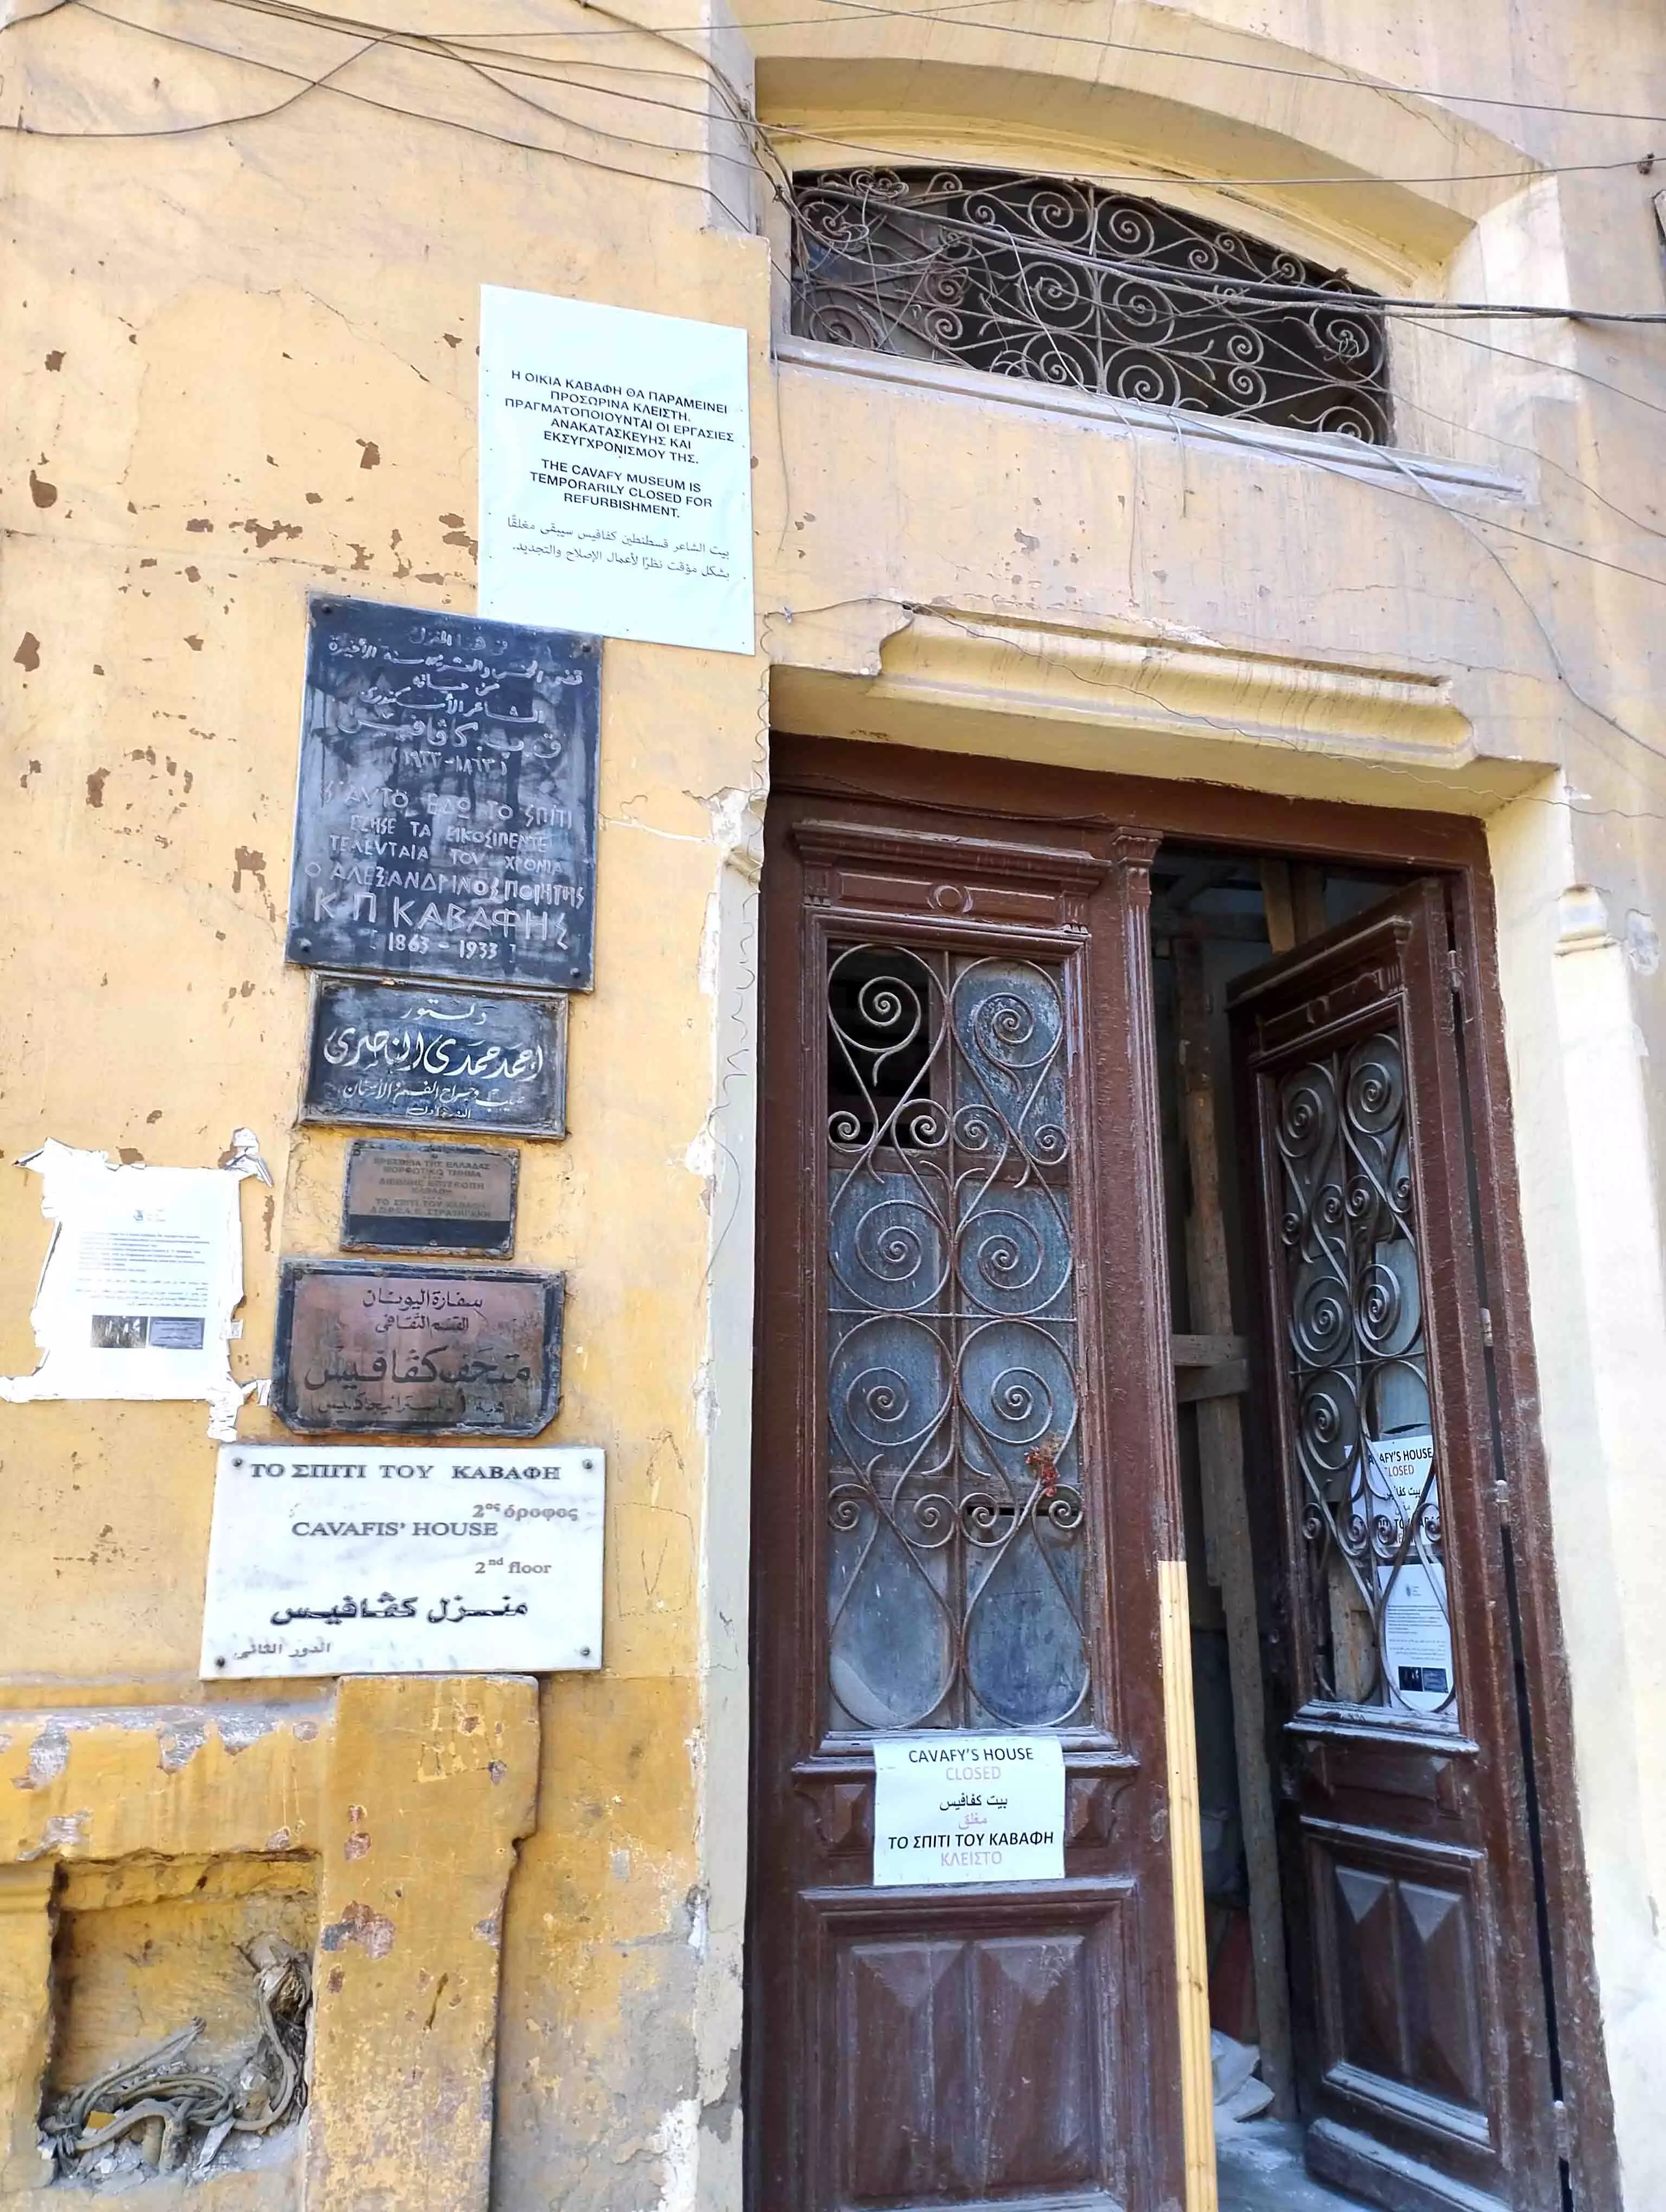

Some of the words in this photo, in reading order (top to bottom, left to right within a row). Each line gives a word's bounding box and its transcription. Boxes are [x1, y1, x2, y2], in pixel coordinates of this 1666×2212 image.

[511, 370, 520, 380] Η
[525, 373, 561, 387] ΟΙΚΙΑ
[566, 379, 621, 395] ΚΑΒΑΦΗ
[626, 388, 644, 399] ΘΑ
[649, 391, 727, 414] ΠΑΡΑΜΕΙΝΕΙ
[550, 390, 629, 410] ΠΡΟΣΩΡΙΝΑ
[633, 403, 691, 421] ΚΛΕΙΣΤΗ.
[505, 398, 652, 430] ΠΡΑΓΜΑΤΟΠΟΙΟΥΝΤΑΙ
[656, 422, 669, 433] ΟΙ
[674, 425, 734, 442] ΕΡΓΑΣΙΕΣ
[551, 418, 667, 446] ΑΝΑΚΑΤΑΣΚΕΥΗΣ
[670, 438, 691, 449] ΚΑΙ
[544, 430, 665, 459] ΕΚΣΥΓΧΡΟΝΙΣΜΟΥ
[669, 451, 699, 464] ΤΗΣ.
[541, 459, 568, 472] THE
[572, 465, 622, 481] CAVAFY
[627, 473, 685, 490] MUSEUM
[689, 482, 701, 492] IS
[530, 472, 624, 495] TEMPORARILY
[629, 487, 682, 503] CLOSED
[686, 496, 712, 507] FOR
[564, 493, 680, 518] REFURBISHMENT.
[672, 542, 705, 552] الشاعر
[709, 546, 729, 560] بيت
[701, 565, 729, 581] بشكل
[410, 821, 432, 838] ΤΑ
[392, 896, 569, 950] ΚΑΒΑΦΗΣ
[362, 1288, 430, 1311] اليونان
[432, 1290, 483, 1310] سفارة
[1403, 1448, 1433, 1462] HOUSE
[251, 1463, 286, 1478] ΤΟ
[291, 1463, 368, 1478] ΣΠΙΤΙ
[379, 1464, 435, 1479] ΤΟΥ
[451, 1465, 562, 1480] ΚΑΒΑΦΗ
[1385, 1464, 1414, 1477] LOSED
[412, 1522, 499, 1536] HOUSE
[507, 1560, 552, 1574] floor
[426, 1594, 529, 1624] منزل
[983, 1747, 1034, 1761] HOUSE
[946, 1766, 1002, 1780] CLOSED
[939, 1792, 982, 1811] كفافيس
[986, 1795, 1008, 1809] بيت
[887, 1836, 909, 1850] ΤΟ
[913, 1834, 951, 1849] ΣΠΙΤΙ
[955, 1833, 985, 1847] ΤΟΥ
[989, 1831, 1054, 1846] ΚΑΒΑΦΗ
[941, 1850, 1003, 1867] ΚΛΕΙΣΤΟ
